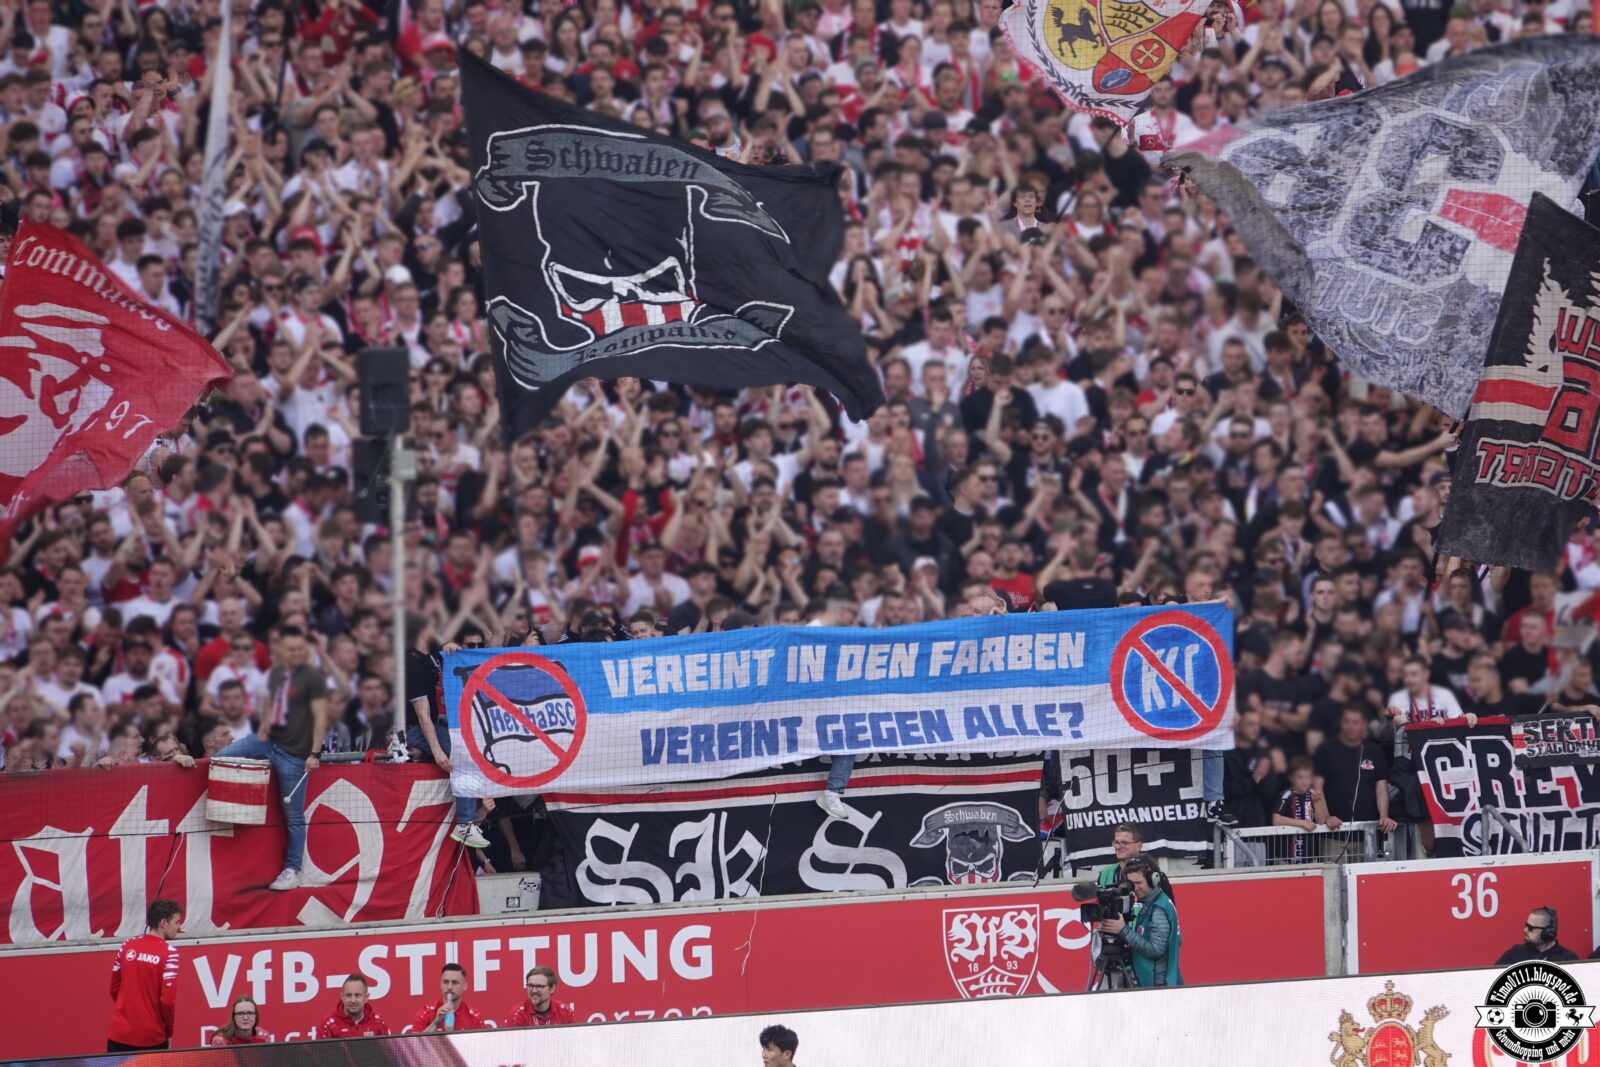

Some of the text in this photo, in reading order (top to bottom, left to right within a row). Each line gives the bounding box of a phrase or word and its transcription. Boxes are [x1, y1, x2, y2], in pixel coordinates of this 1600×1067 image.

[525, 139, 702, 180] Schwaben
[105, 400, 155, 439] 97
[602, 632, 1086, 698] VEREINT IN DEN FARBEN
[640, 702, 1085, 767] VEREINT GEGEN ALLE?
[944, 808, 998, 824] Schwaben
[296, 777, 457, 925] 97
[1451, 872, 1499, 920] 36
[137, 952, 160, 965] JAKO
[193, 923, 713, 1009] VfB-STIFTUNG
[967, 960, 1018, 973] 18 93
